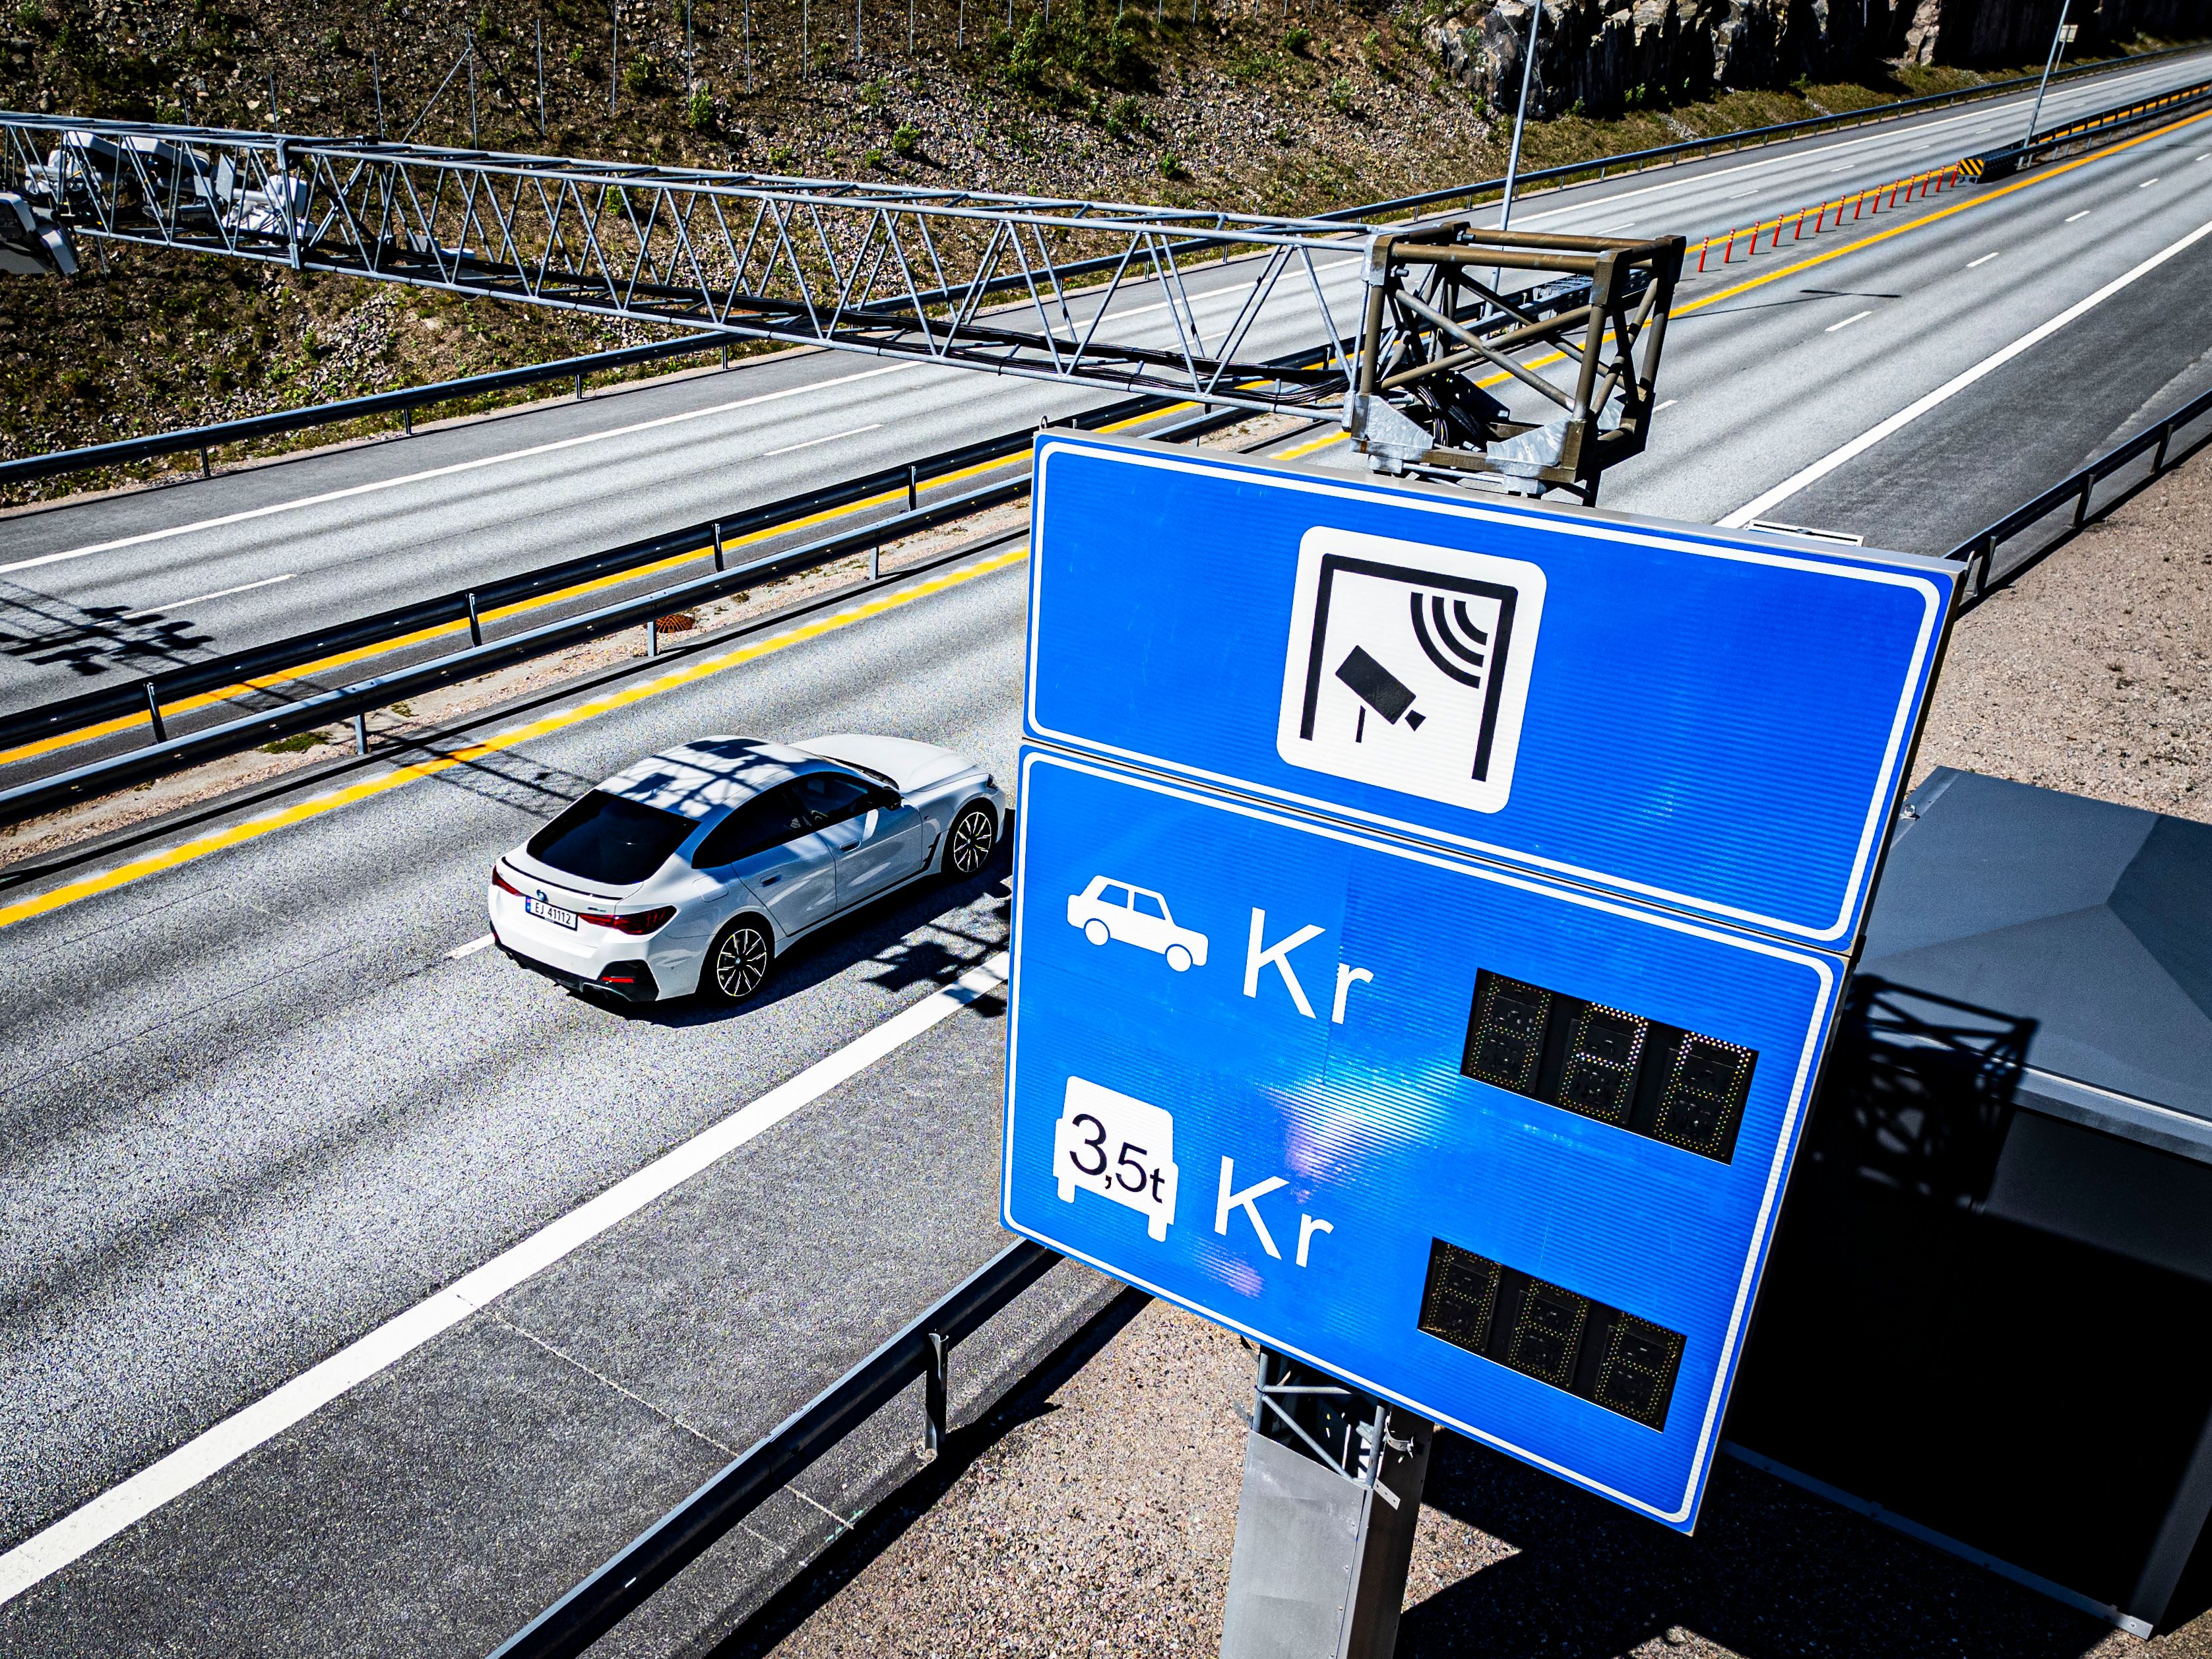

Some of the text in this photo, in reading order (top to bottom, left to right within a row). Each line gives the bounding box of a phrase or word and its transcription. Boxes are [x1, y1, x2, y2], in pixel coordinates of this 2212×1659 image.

[536, 902, 544, 915] EJ
[548, 908, 571, 925] 41112
[1243, 906, 1374, 1025] Kr
[1069, 1113, 1166, 1204] 3,5t
[1214, 1155, 1335, 1268] Kr
